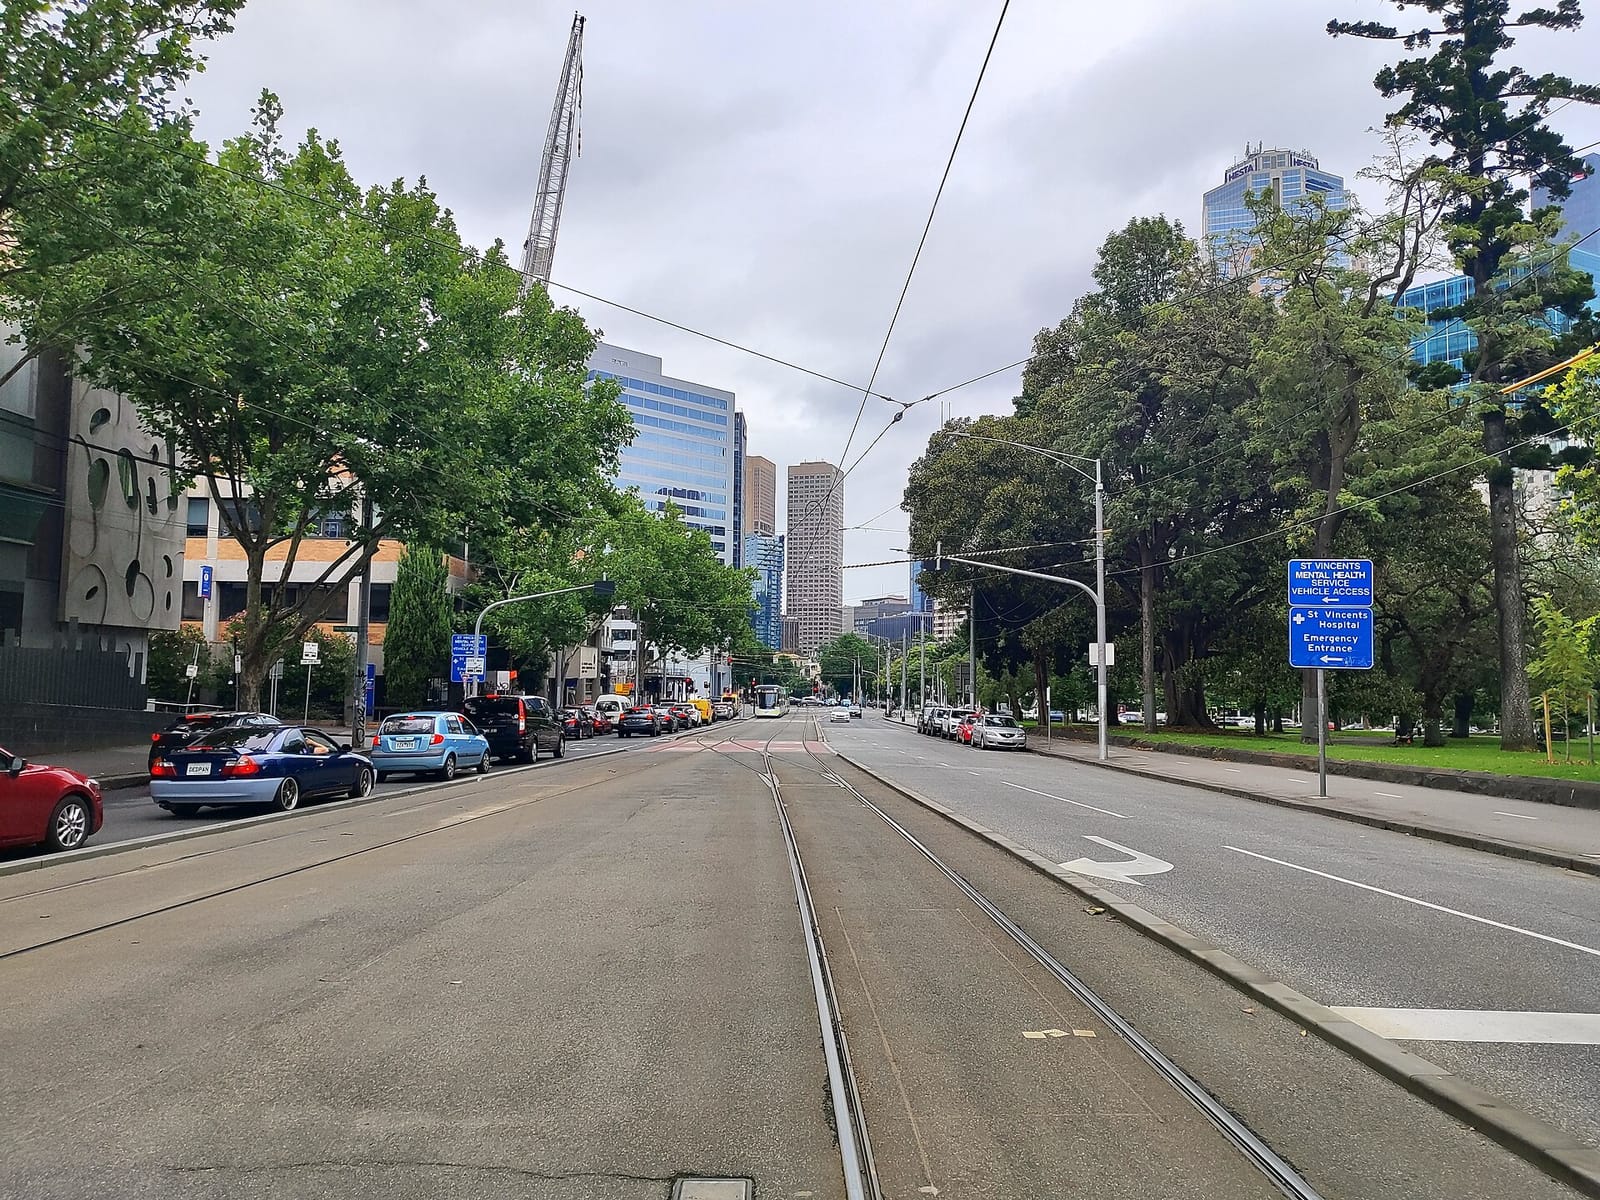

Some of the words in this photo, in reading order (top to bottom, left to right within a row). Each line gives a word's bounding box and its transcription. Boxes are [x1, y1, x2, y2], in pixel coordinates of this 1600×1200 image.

[1228, 164, 1254, 182] HESTA
[1300, 562, 1312, 570] ST
[1315, 562, 1361, 570] VINCENTS
[1295, 571, 1330, 579] MENTAL
[1333, 571, 1366, 579] HEALTH
[1311, 579, 1350, 587] SERVICE
[1292, 587, 1330, 595] VEHICLE
[1333, 587, 1370, 596] ACCESS
[1307, 610, 1319, 618] St
[1325, 610, 1368, 619] Vincents
[1319, 620, 1360, 629] Hospital
[1303, 633, 1358, 644] Emergency
[1307, 643, 1353, 652] Entrance
